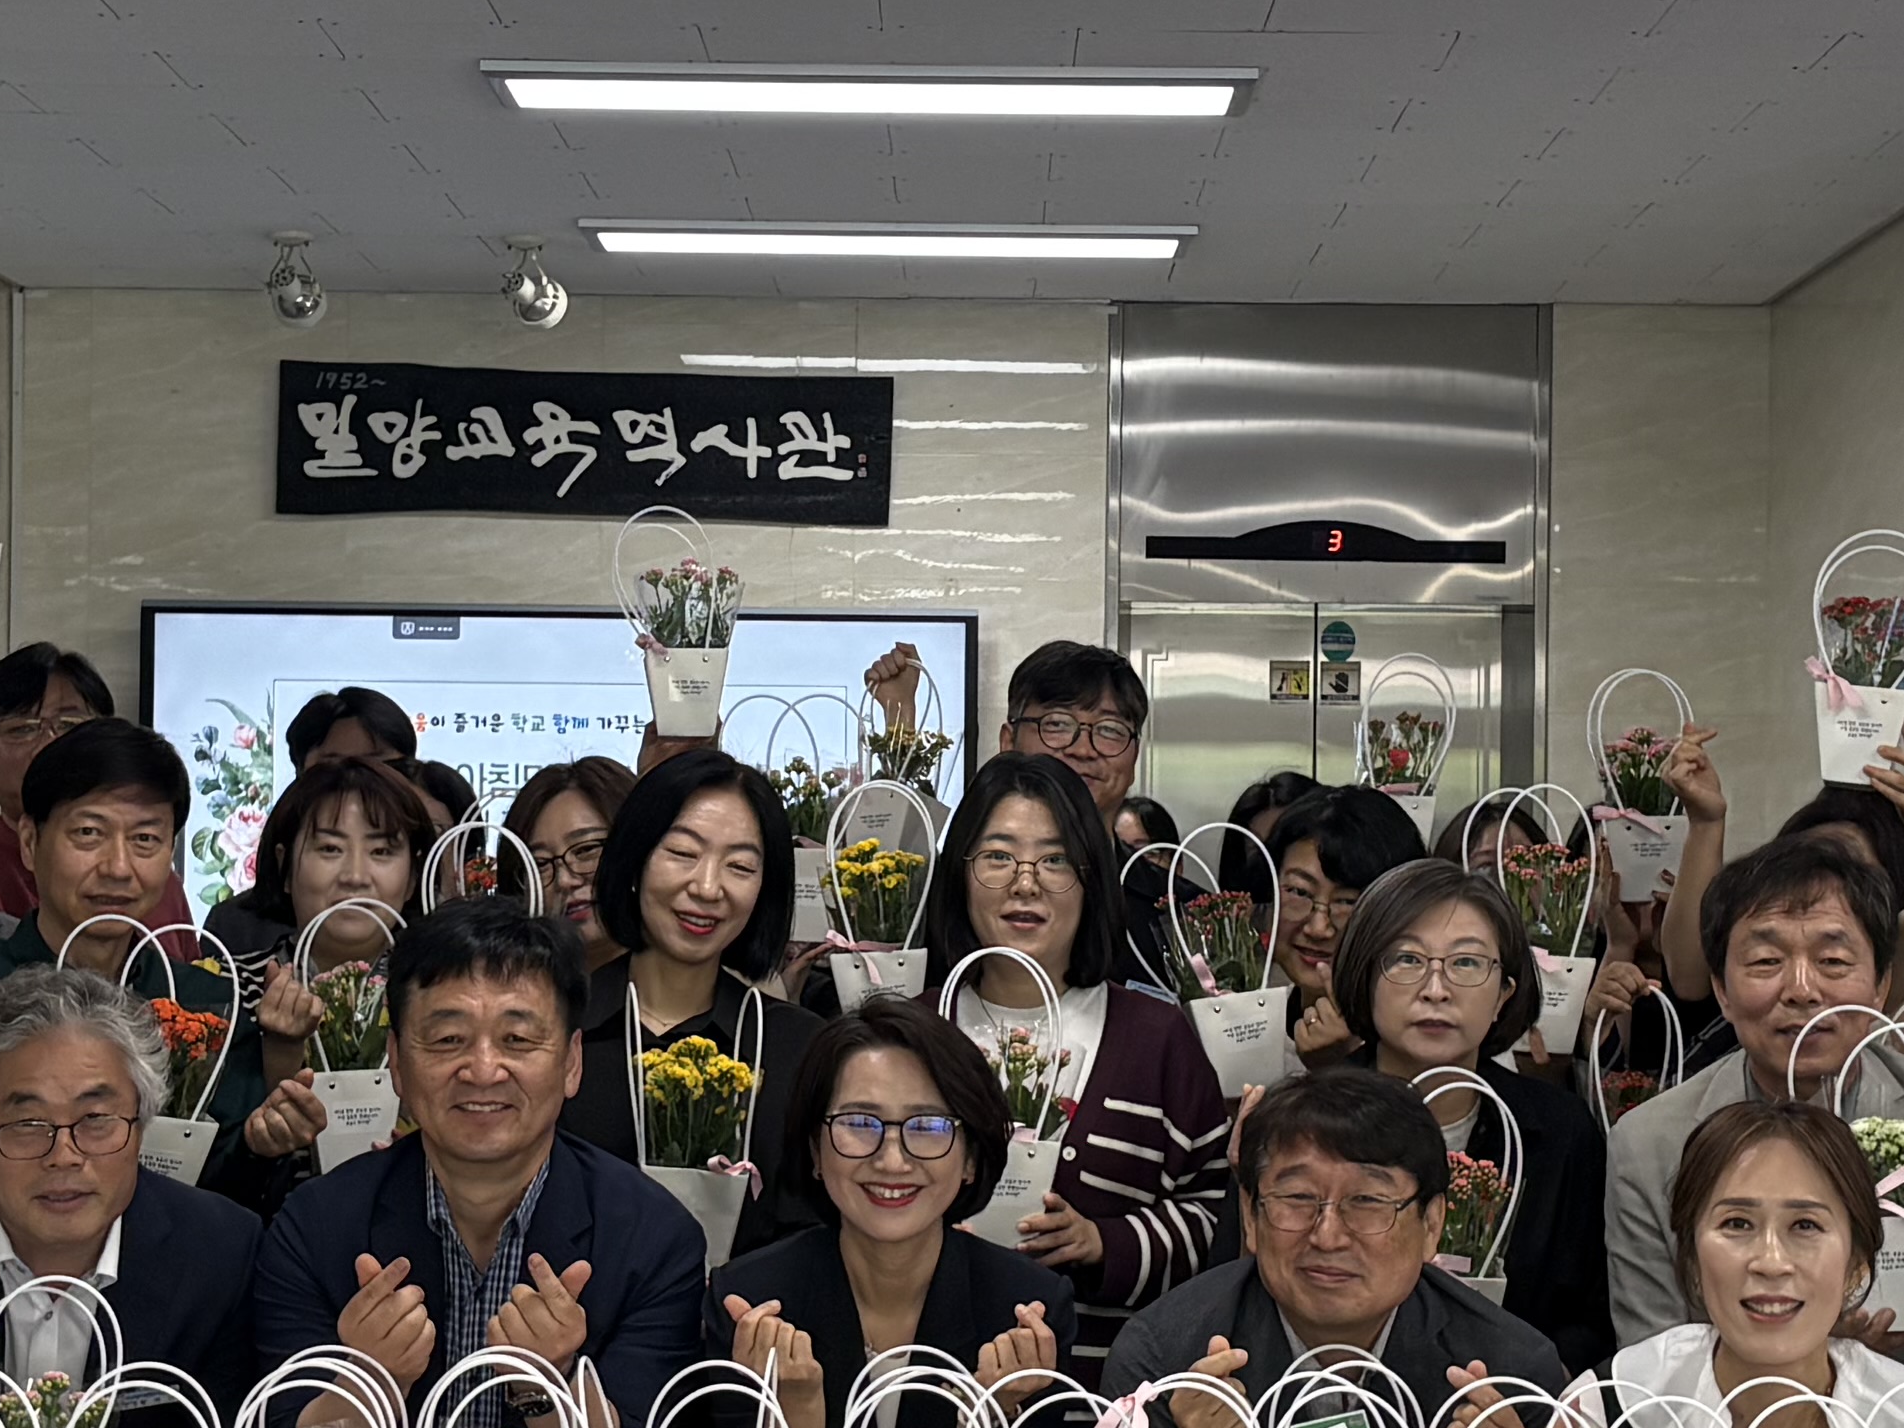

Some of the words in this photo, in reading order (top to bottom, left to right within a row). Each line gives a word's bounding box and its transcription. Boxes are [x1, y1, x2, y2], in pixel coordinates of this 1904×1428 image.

[1328, 529, 1343, 552] 3
[453, 712, 504, 733] 즐거운
[511, 713, 546, 733] 학교
[552, 713, 589, 734] 함께
[596, 714, 646, 734] 가꾸는
